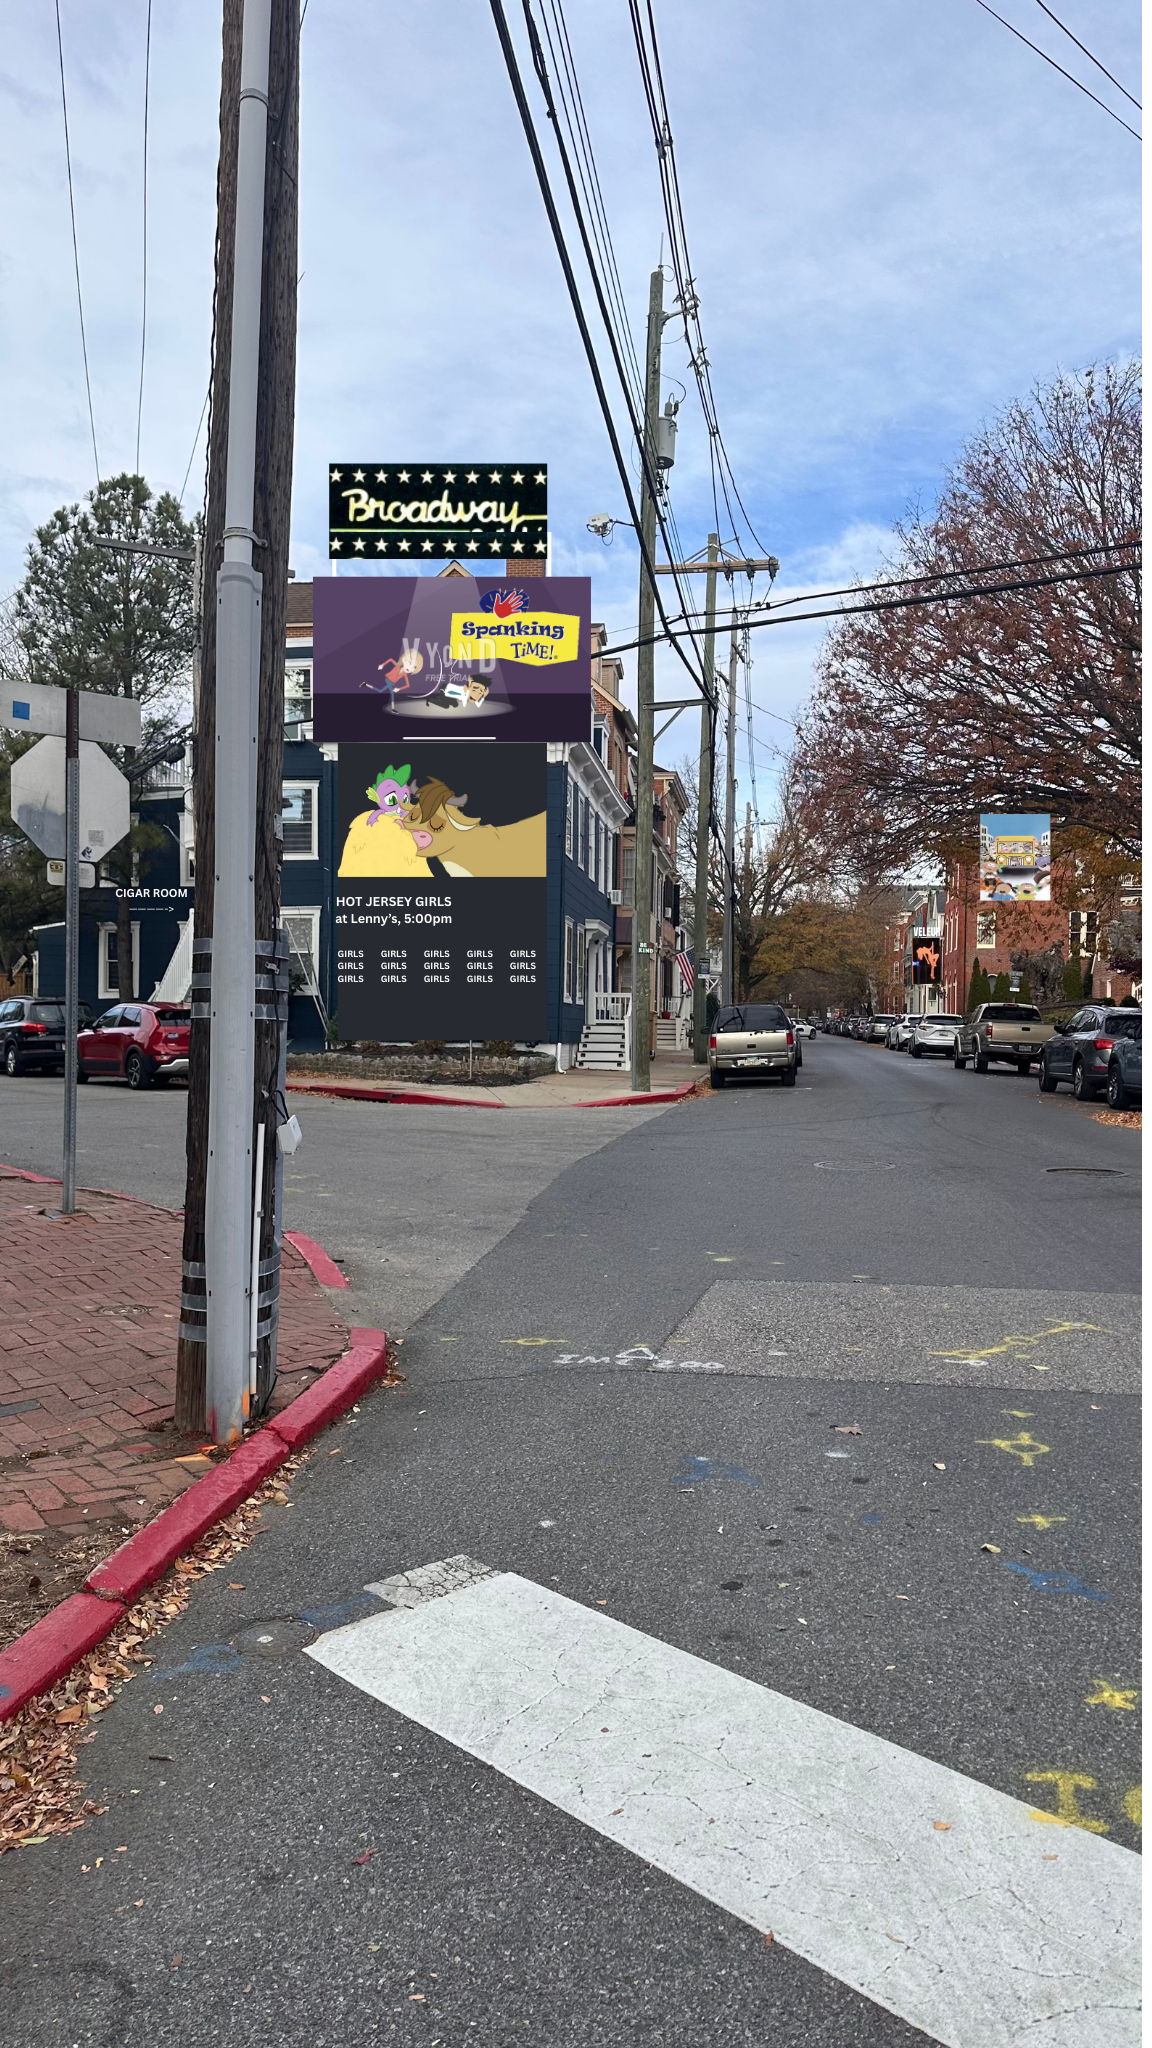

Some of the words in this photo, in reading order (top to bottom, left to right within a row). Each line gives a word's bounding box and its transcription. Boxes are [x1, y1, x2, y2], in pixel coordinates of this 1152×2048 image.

[341, 488, 547, 532] Broadway
[461, 621, 564, 640] Spanking
[425, 674, 447, 682] FREE
[448, 674, 472, 682] TRIAL
